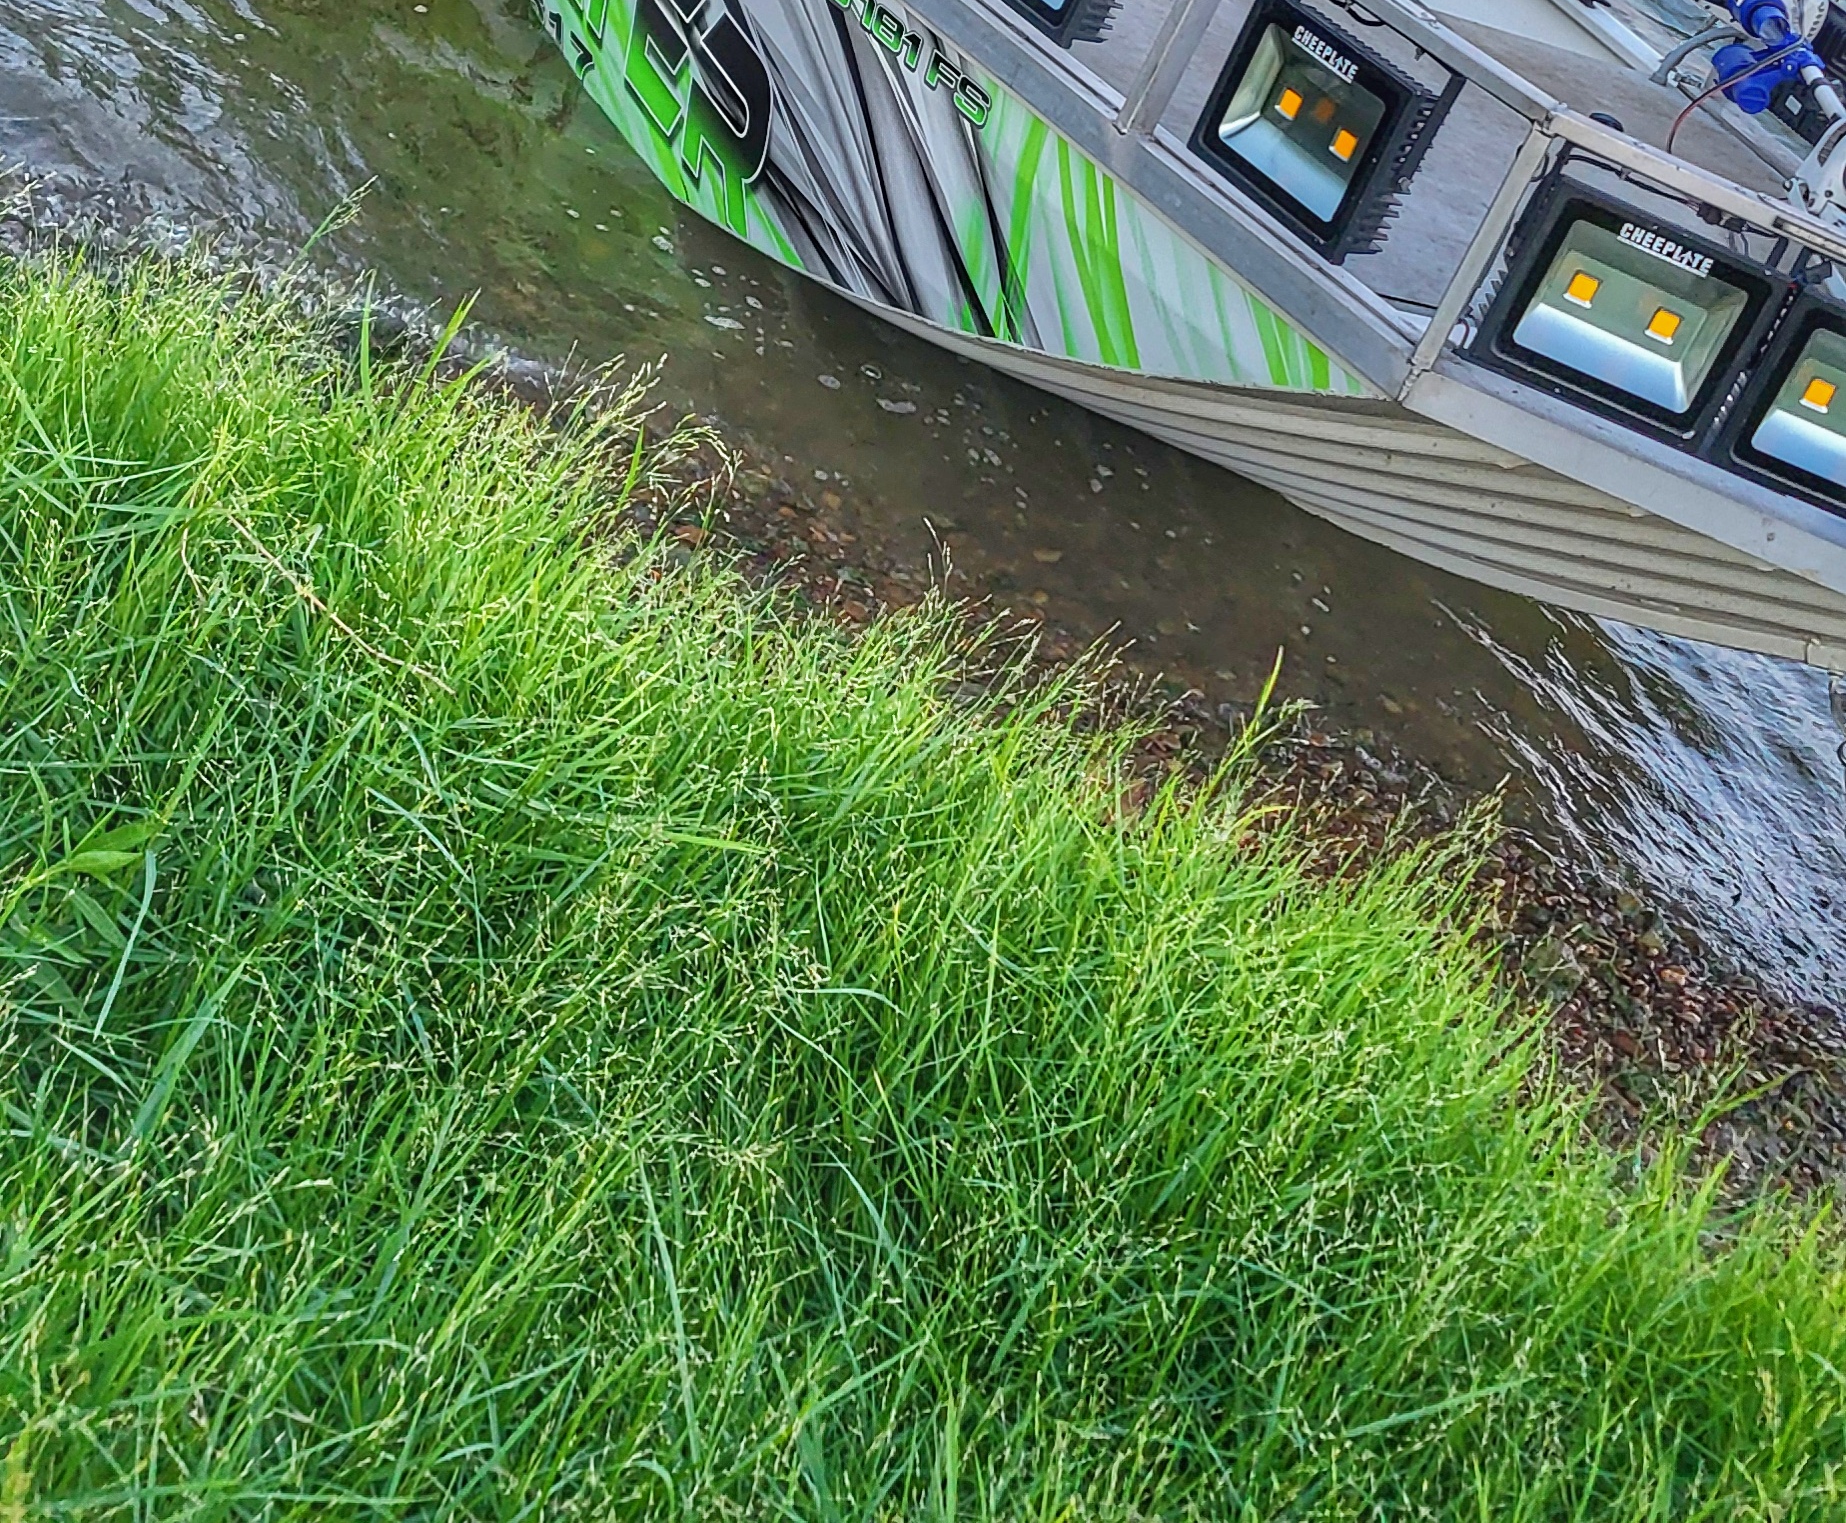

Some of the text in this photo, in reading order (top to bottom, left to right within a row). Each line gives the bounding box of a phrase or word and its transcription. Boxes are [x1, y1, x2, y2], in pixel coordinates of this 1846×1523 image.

[1294, 25, 1359, 80] CHEEPLATE
[924, 49, 993, 130] FS
[1619, 222, 1714, 275] CHEEPLATE
